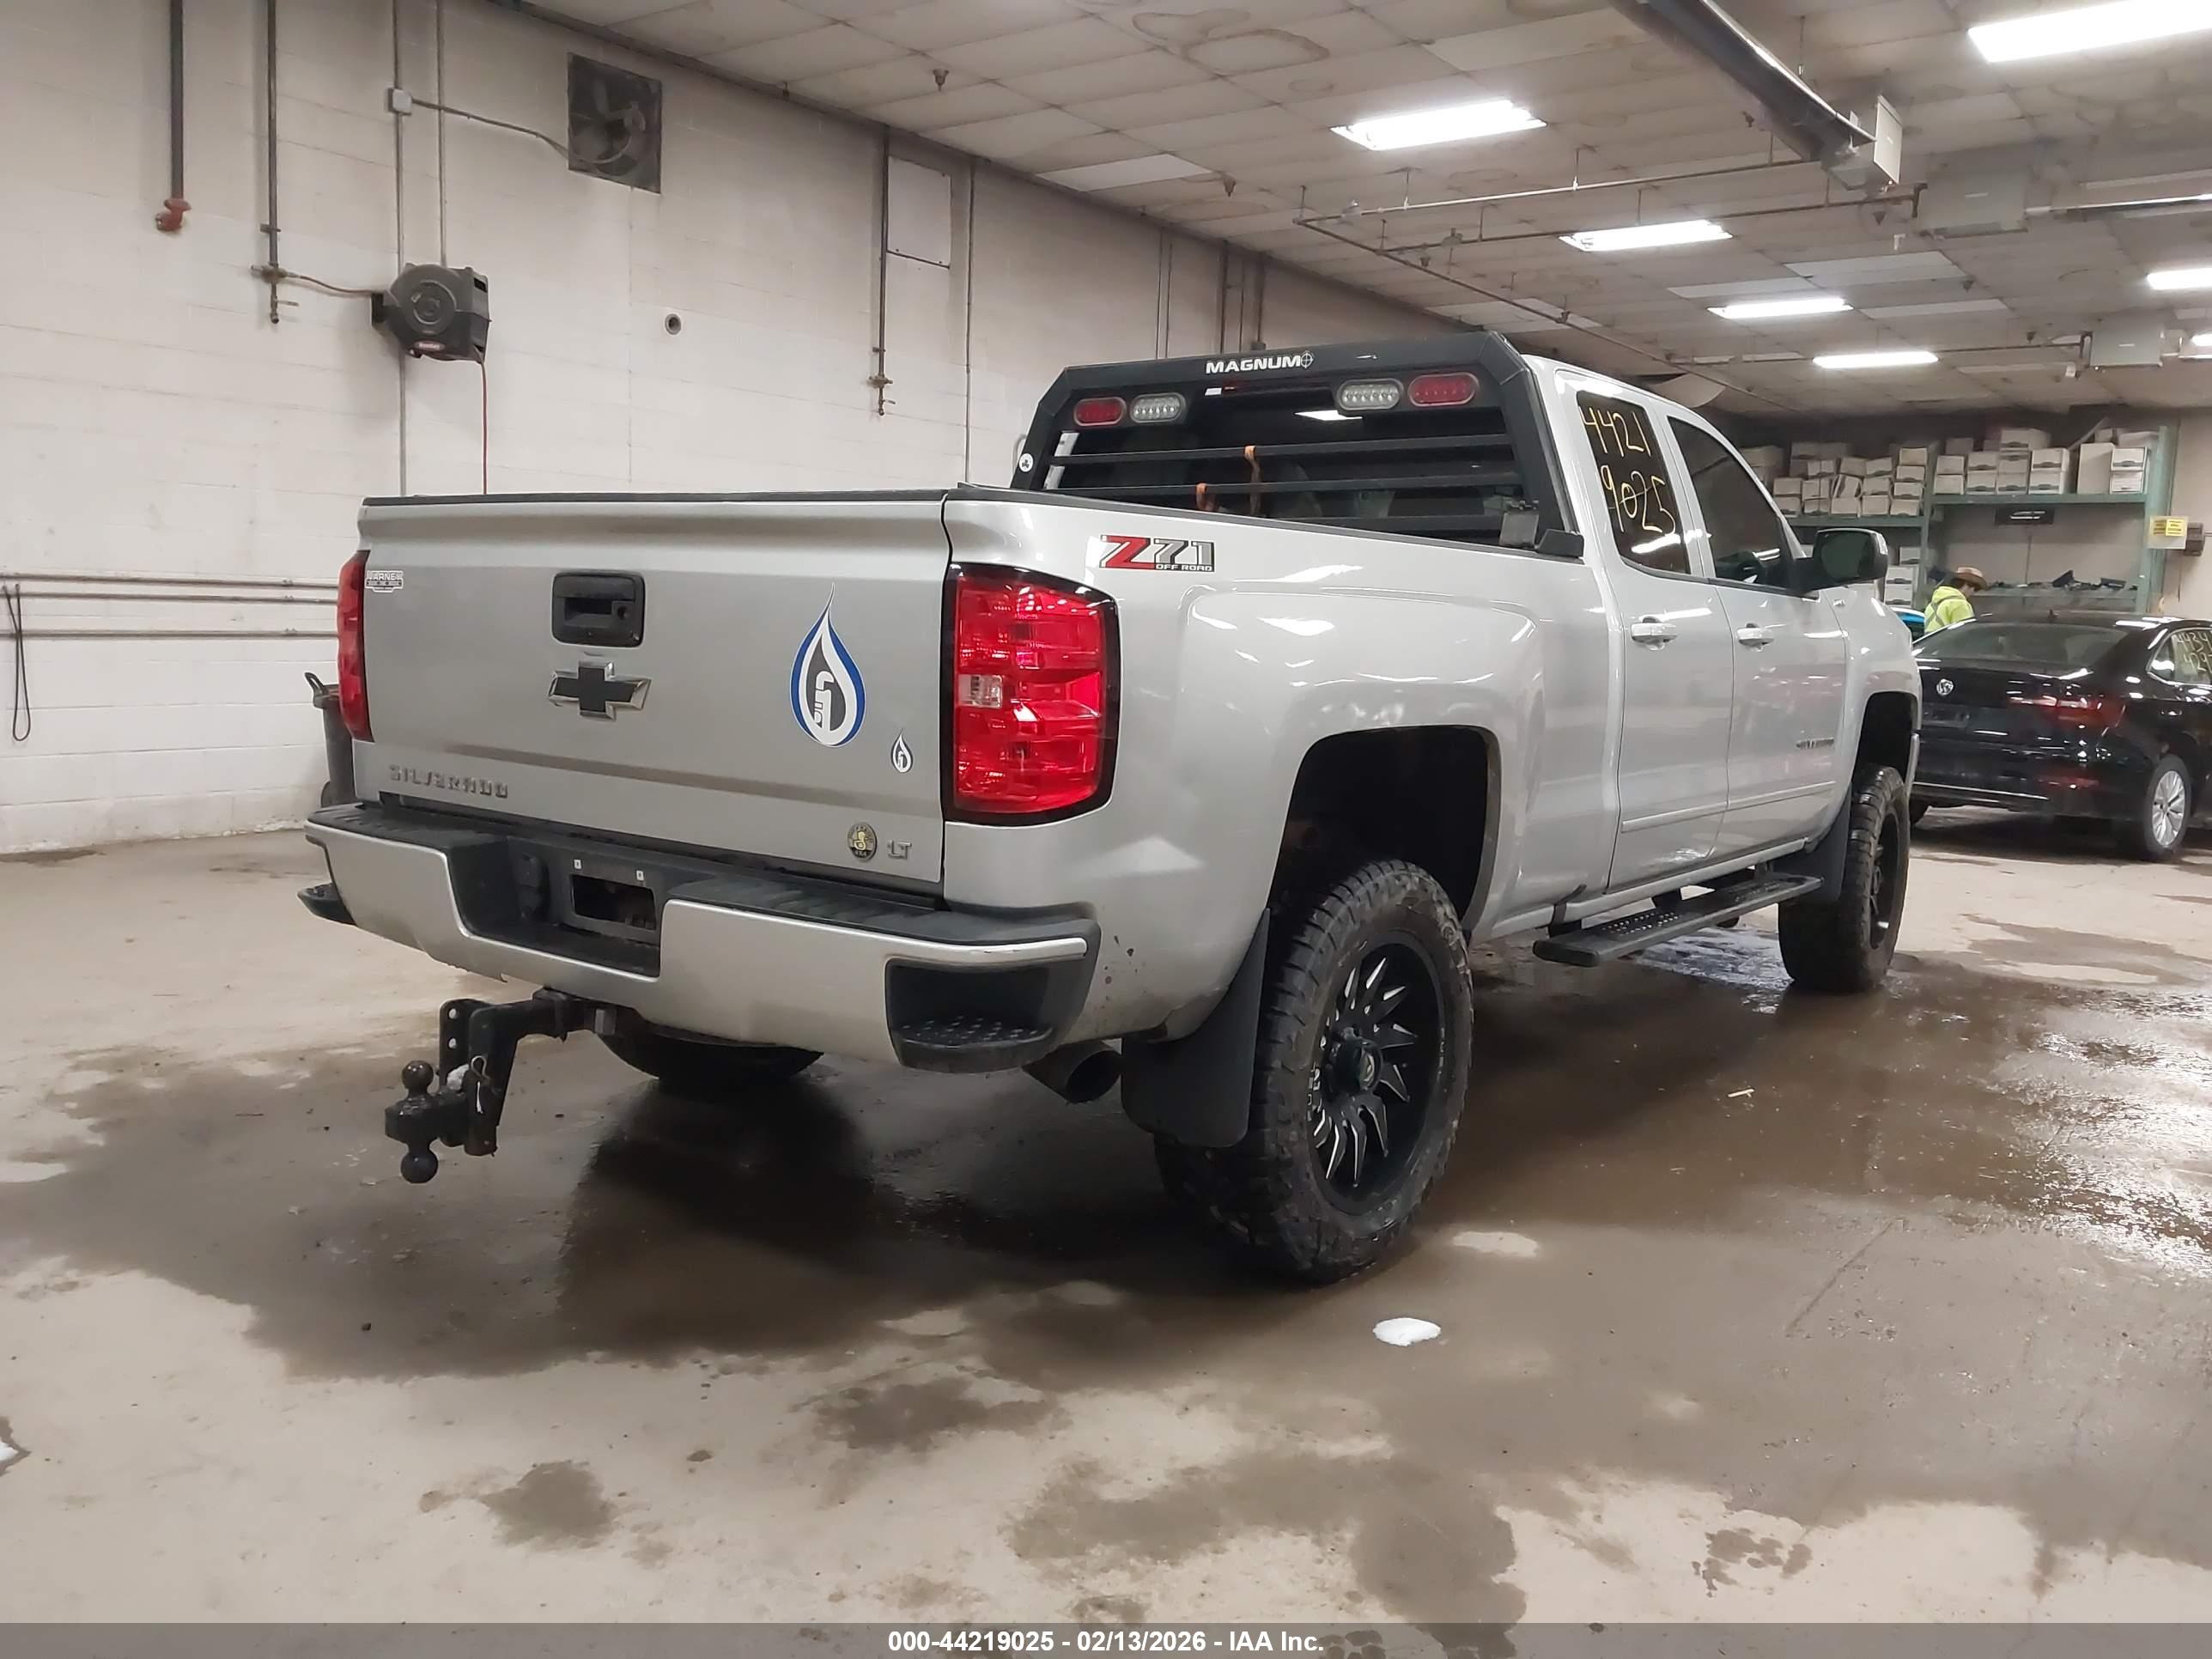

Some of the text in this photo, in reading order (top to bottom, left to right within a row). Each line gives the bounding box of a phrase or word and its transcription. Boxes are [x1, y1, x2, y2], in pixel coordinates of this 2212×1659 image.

[1206, 355, 1302, 374] MAGNUM
[1578, 407, 1651, 457] 4421
[1601, 465, 1675, 538] 9025
[1099, 534, 1214, 570] Z71
[2183, 652, 2212, 674] 429
[389, 763, 508, 799] SILVERADO
[887, 839, 913, 860] LT
